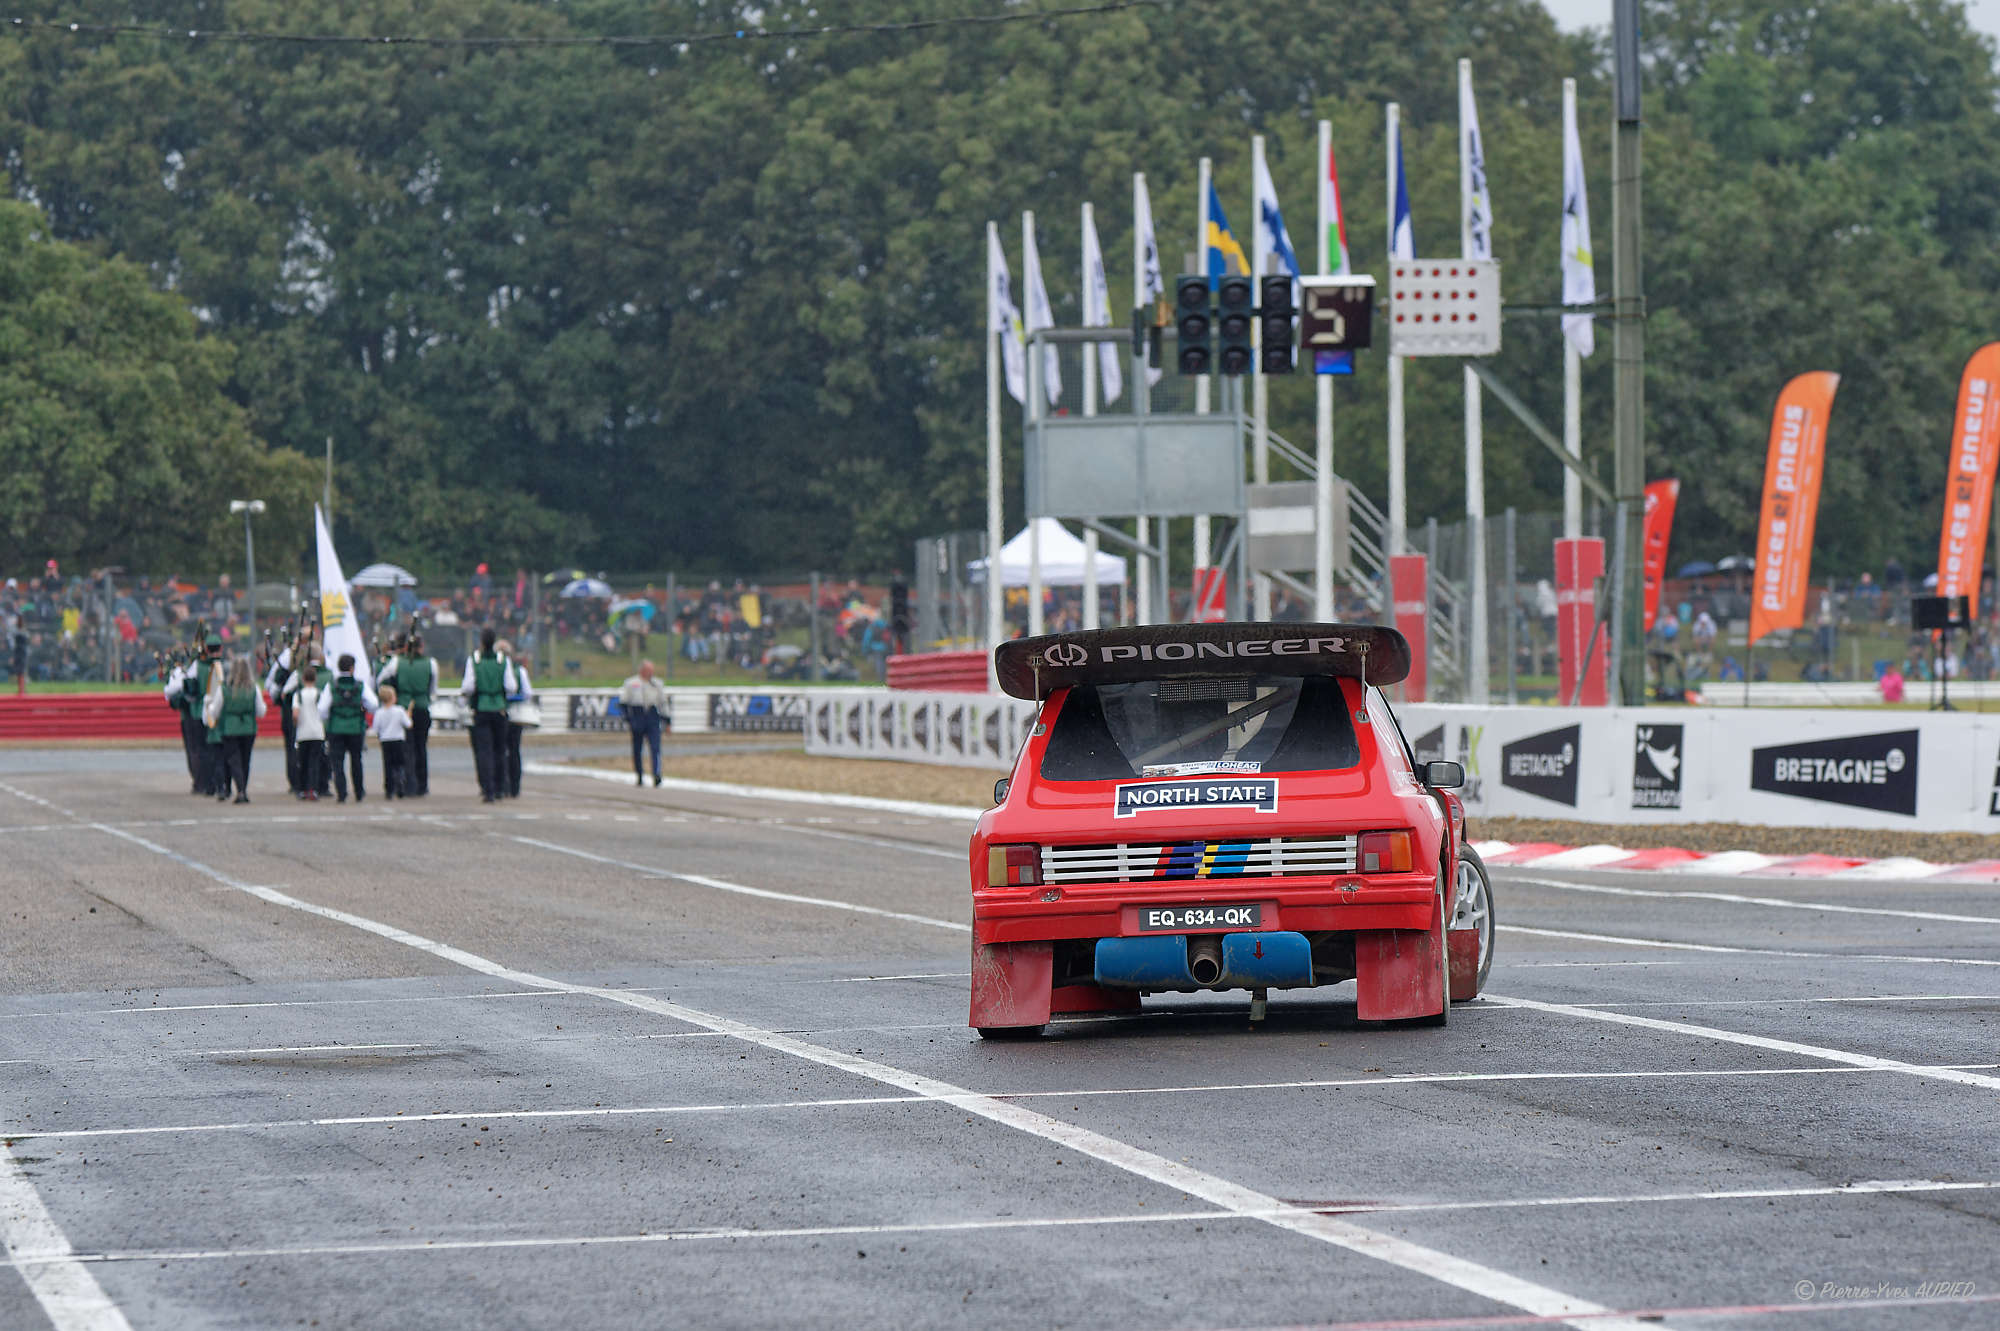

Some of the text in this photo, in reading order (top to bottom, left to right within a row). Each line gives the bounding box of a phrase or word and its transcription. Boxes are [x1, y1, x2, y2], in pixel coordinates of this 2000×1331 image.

[1959, 378, 1988, 473] pneus
[1776, 405, 1804, 492] pneus
[1101, 637, 1347, 663] PIONEER
[1510, 754, 1564, 777] BRETAGNE
[1774, 757, 1887, 784] BRETAGNE
[1127, 786, 1267, 805] NORTH STATE
[1148, 908, 1252, 926] EQ-634-QK
